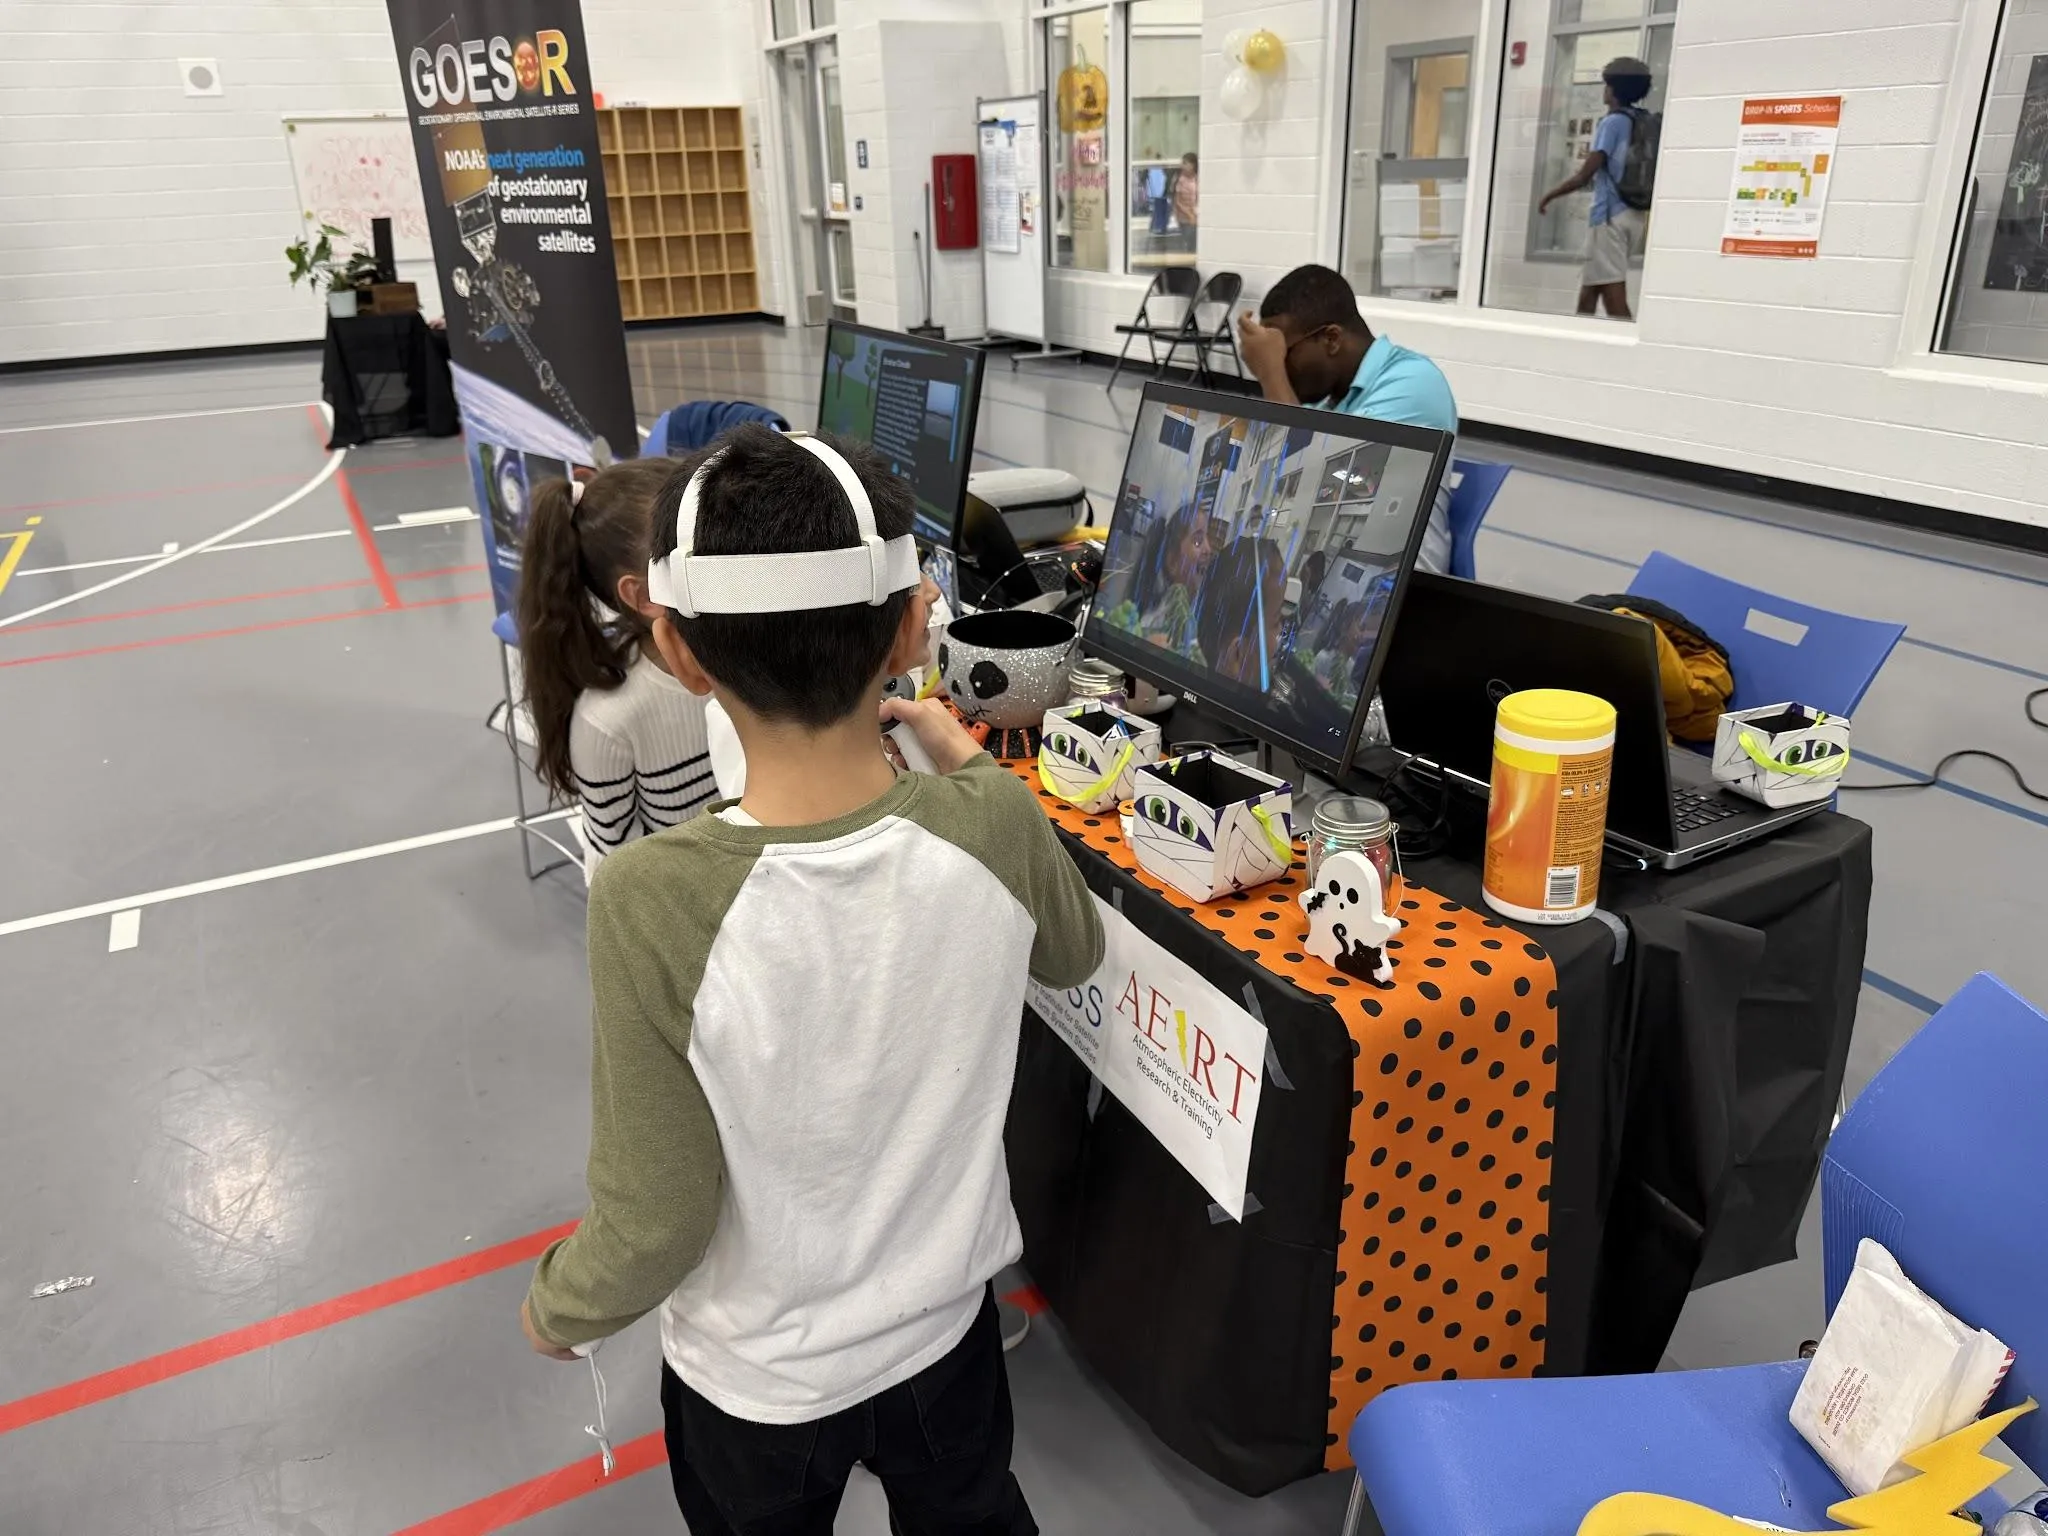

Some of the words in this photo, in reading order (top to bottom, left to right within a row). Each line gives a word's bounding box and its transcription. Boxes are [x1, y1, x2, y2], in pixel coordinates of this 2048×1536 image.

[558, 103, 579, 115] SERIES
[1774, 103, 1803, 114] SPORTS
[445, 149, 486, 171] NOAA's
[486, 149, 513, 169] next
[516, 145, 584, 174] generation
[488, 176, 501, 197] of
[503, 174, 588, 201] geostationary
[500, 202, 592, 225] environmental
[538, 230, 597, 253] satellites
[1183, 691, 1197, 704] DELL
[1050, 1011, 1074, 1039] System
[1064, 1009, 1074, 1023] for
[1073, 1019, 1100, 1049] Satellite
[1132, 1033, 1182, 1087] Atmospheric
[1182, 1074, 1224, 1126] Electricity
[1136, 1056, 1171, 1097] Research
[1172, 1085, 1180, 1104] &
[1179, 1092, 1214, 1140] Training
